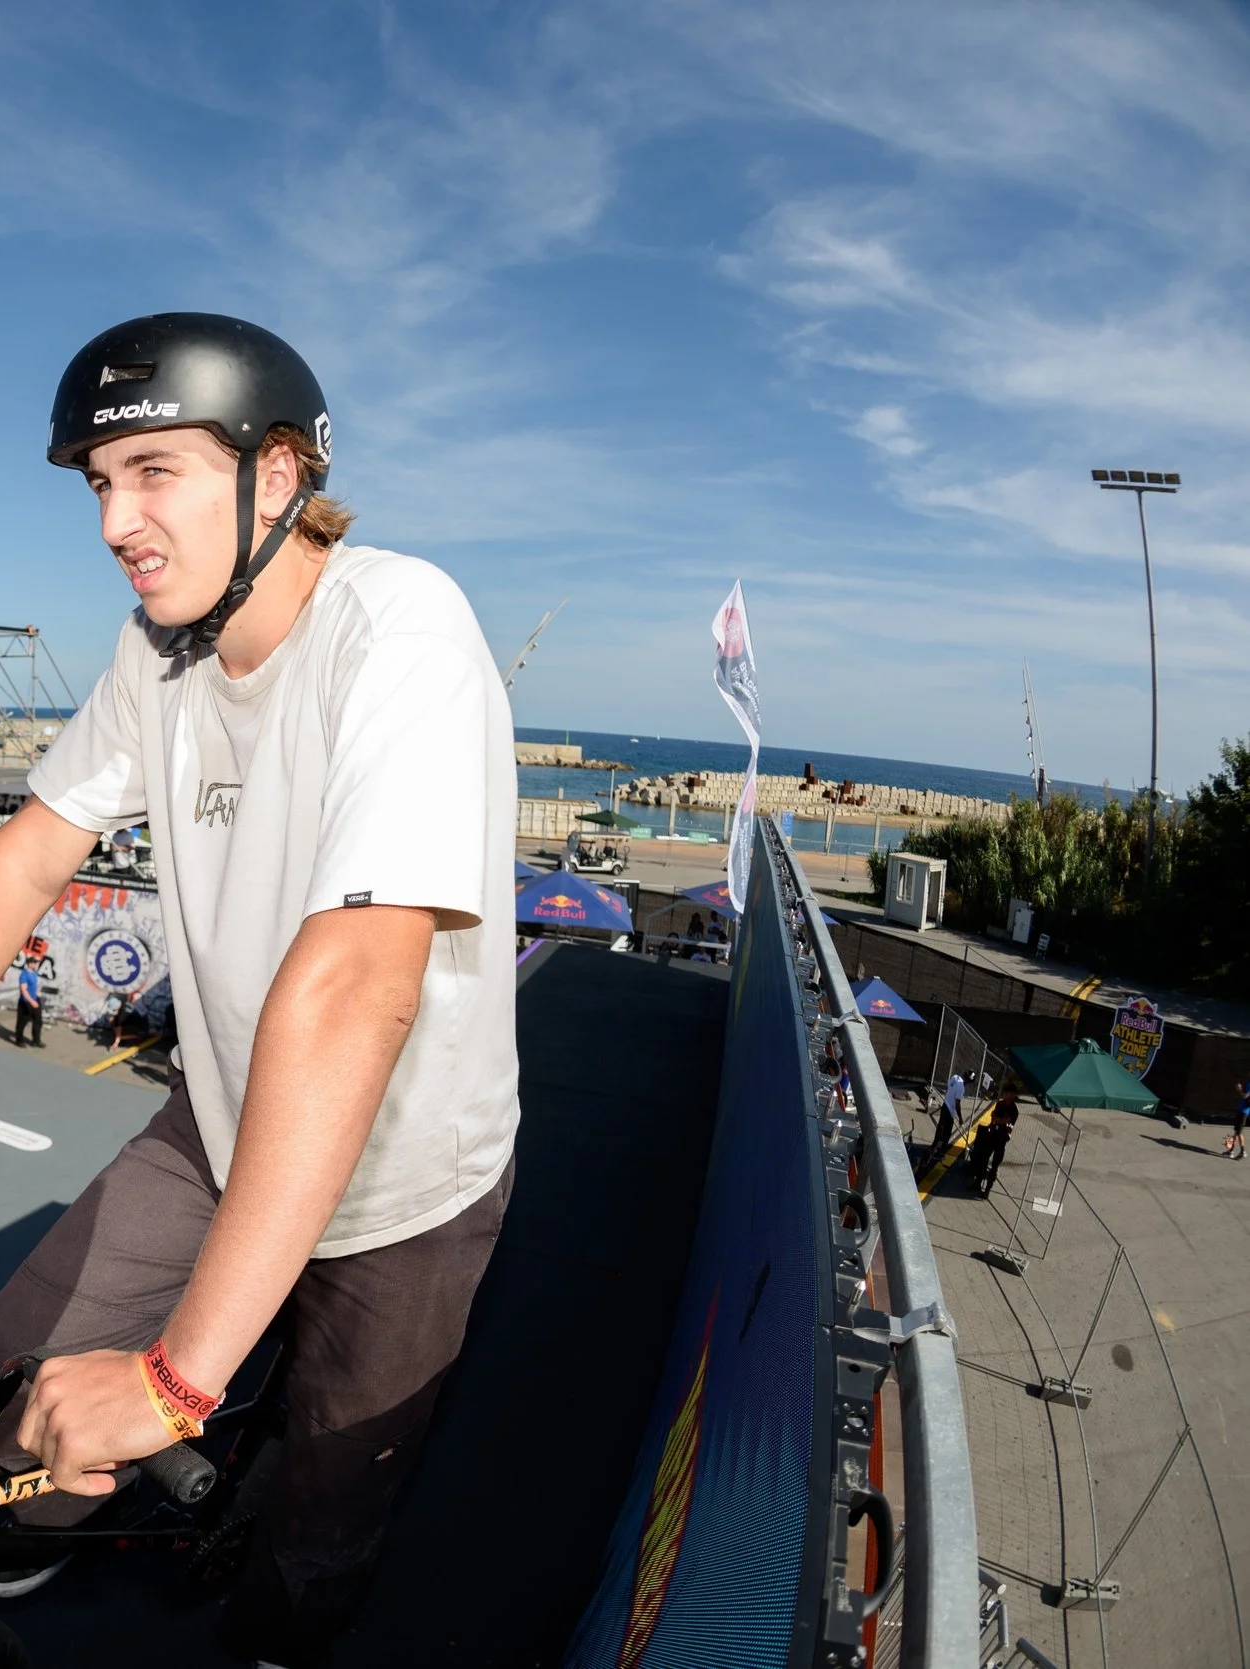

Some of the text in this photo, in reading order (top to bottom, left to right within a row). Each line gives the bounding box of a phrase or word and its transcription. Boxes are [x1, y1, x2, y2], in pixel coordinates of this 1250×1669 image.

[194, 779, 243, 828] VAN
[534, 906, 587, 919] Red Bull
[1113, 1024, 1161, 1047] ATHLETE
[1119, 1040, 1149, 1058] ZONE
[150, 1353, 203, 1410] EXTREME
